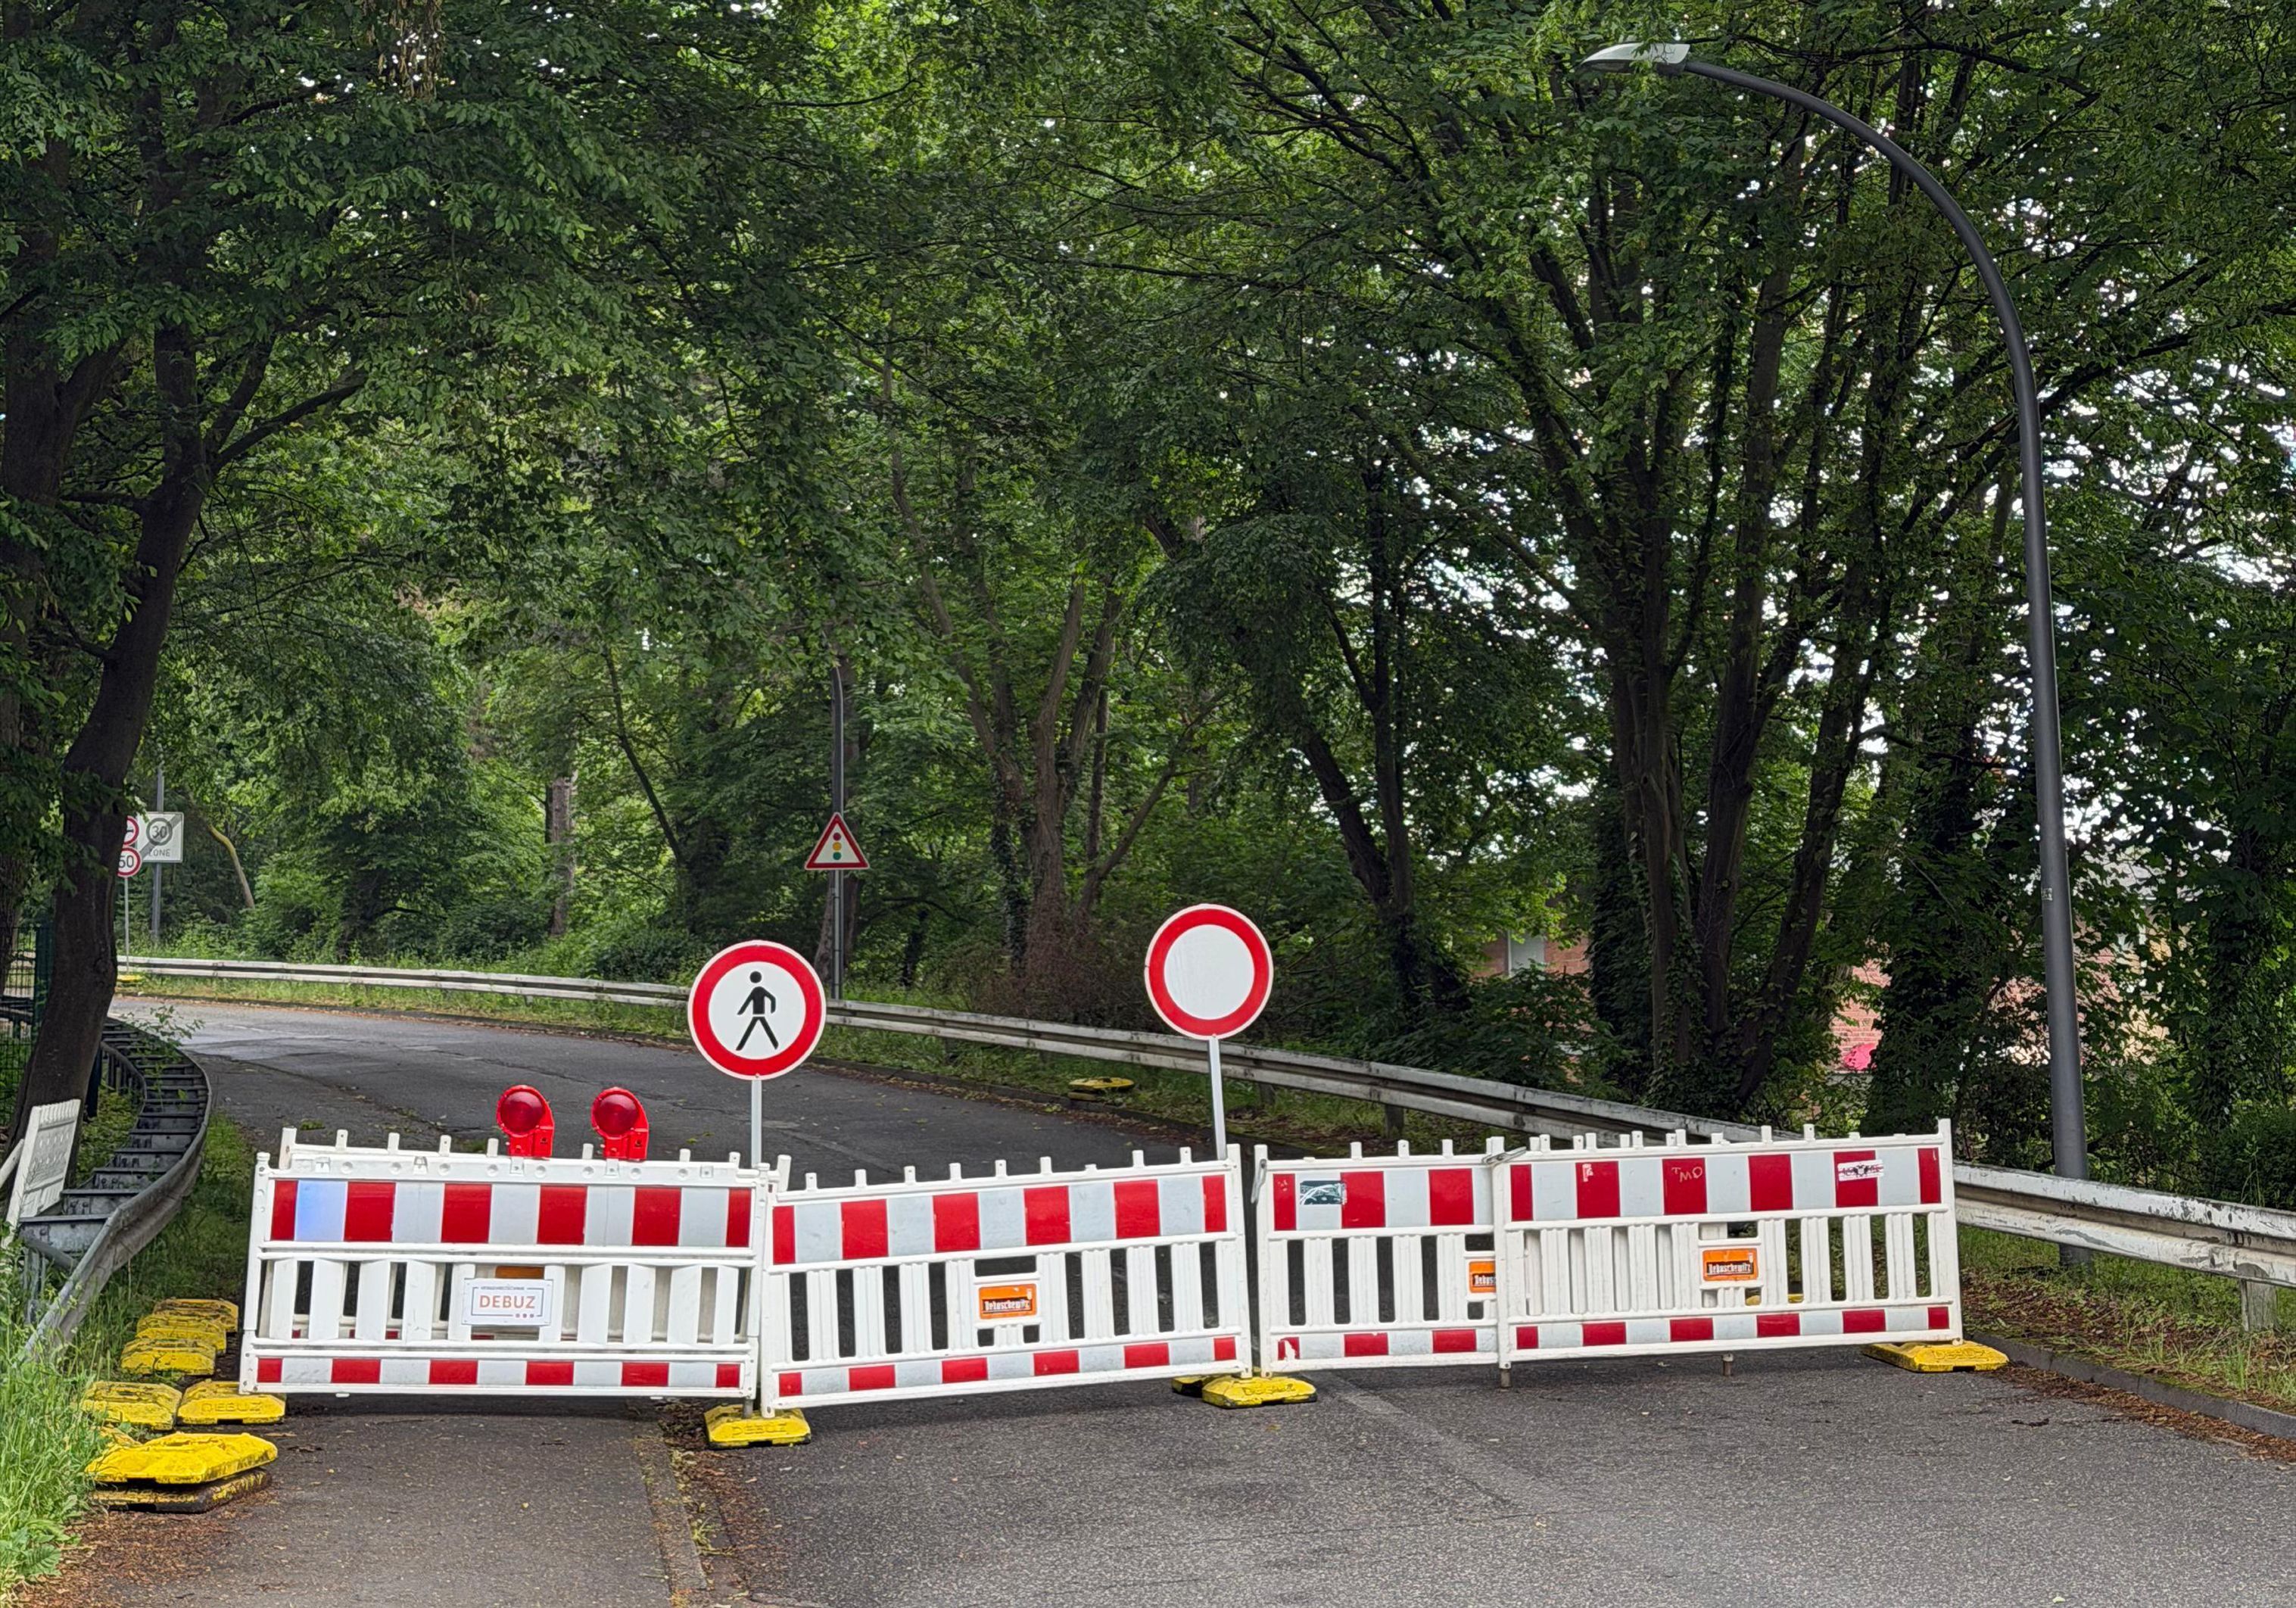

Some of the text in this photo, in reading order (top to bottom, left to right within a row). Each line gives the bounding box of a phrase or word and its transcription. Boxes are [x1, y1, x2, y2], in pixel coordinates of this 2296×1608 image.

[152, 825, 167, 839] 30
[479, 1295, 536, 1308] DEBUZ
[201, 1401, 262, 1413] DEBUZ
[731, 1422, 787, 1436] DEBUZ
